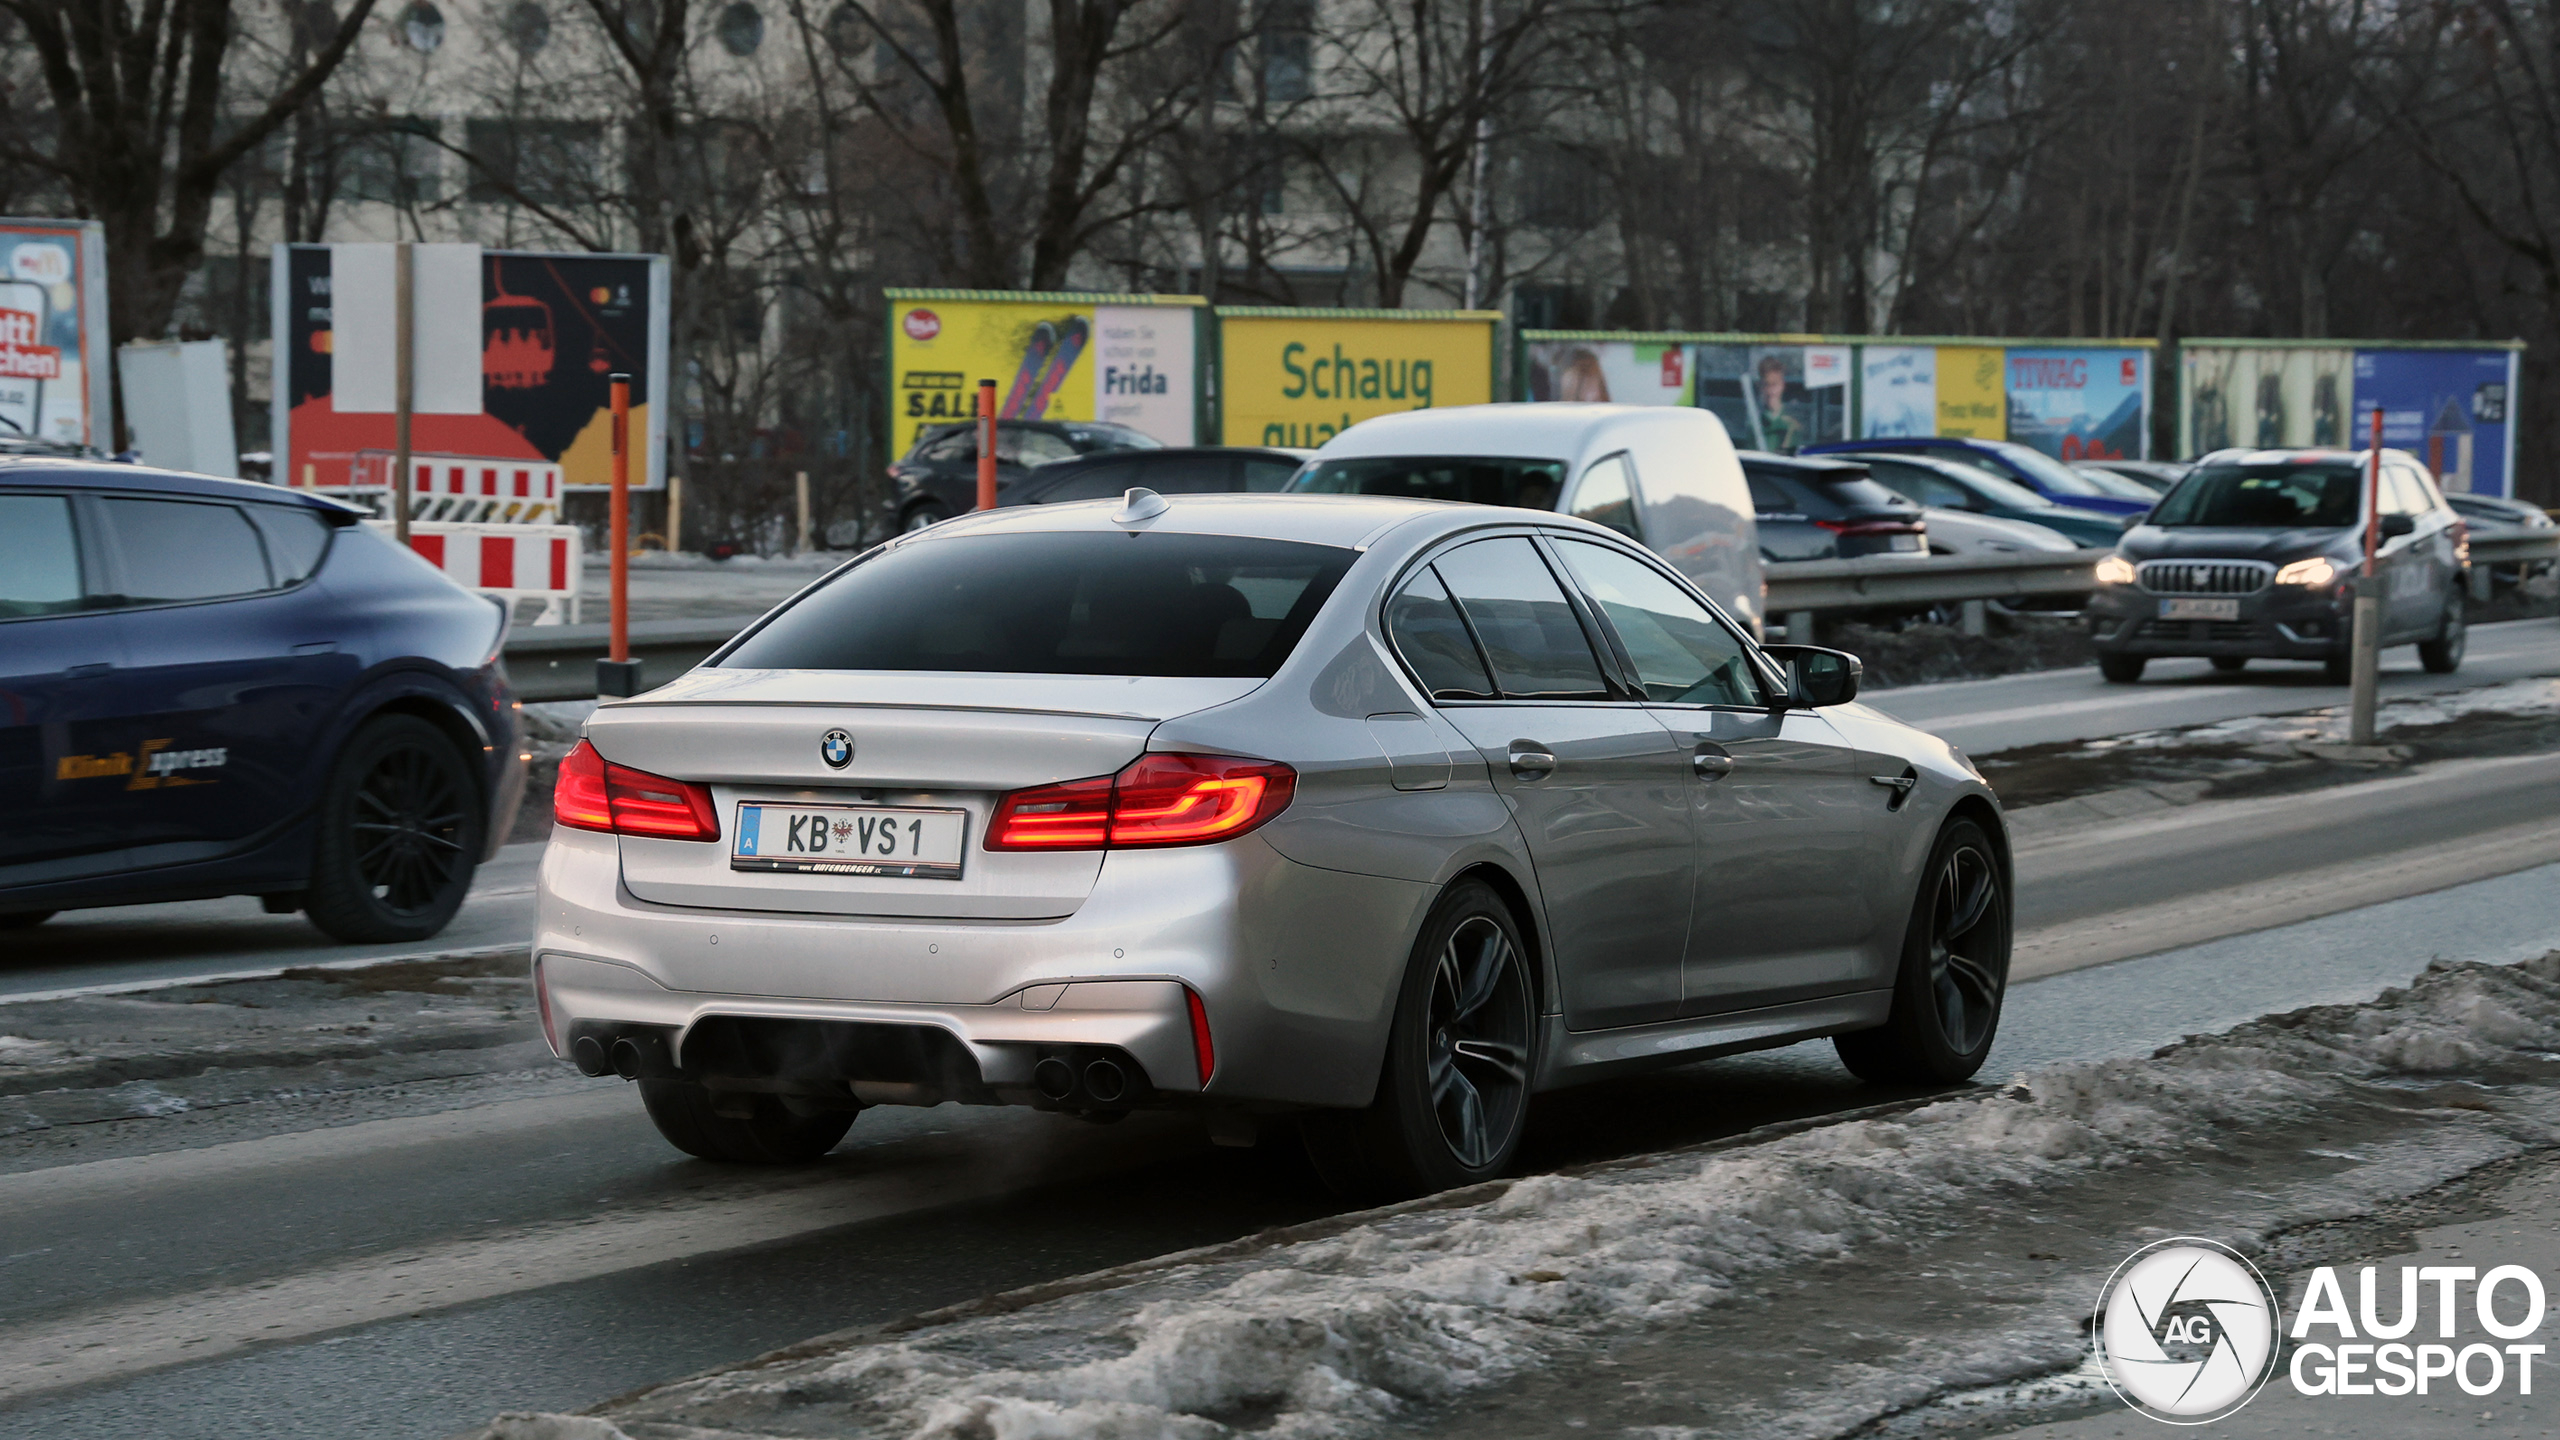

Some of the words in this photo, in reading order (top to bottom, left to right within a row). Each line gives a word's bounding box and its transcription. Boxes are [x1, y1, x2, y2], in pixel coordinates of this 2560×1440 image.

[1104, 363, 1167, 395] Frida
[1282, 341, 1432, 411] Schaug
[2012, 358, 2087, 389] TIWAG
[824, 732, 852, 745] BMW
[743, 839, 753, 849] A
[787, 814, 829, 852] KB
[858, 816, 897, 855] VS
[908, 818, 922, 856] 1
